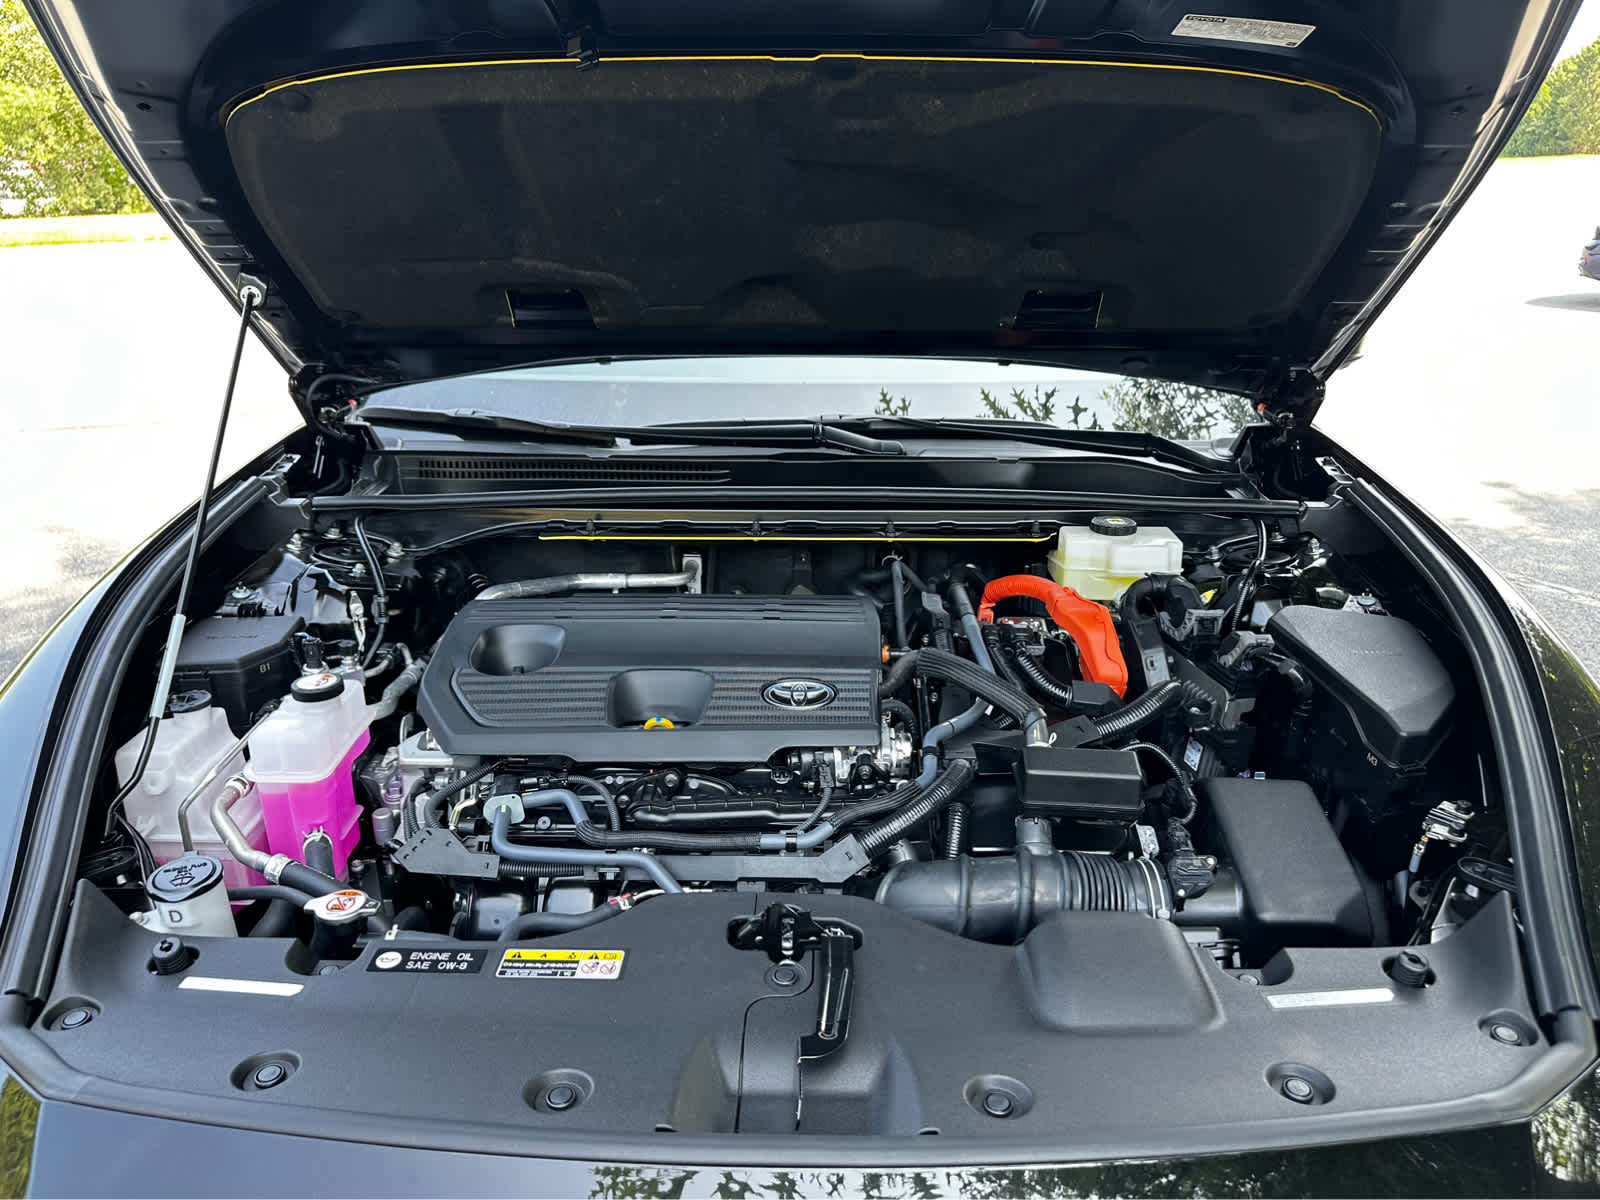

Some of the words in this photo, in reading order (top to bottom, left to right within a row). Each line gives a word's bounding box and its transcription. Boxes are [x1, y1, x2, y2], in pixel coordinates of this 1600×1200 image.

[168, 910, 183, 923] D
[410, 951, 451, 961] ENGINE
[456, 953, 474, 961] OIL
[406, 961, 431, 970] SAE
[437, 961, 468, 970] 0W-8
